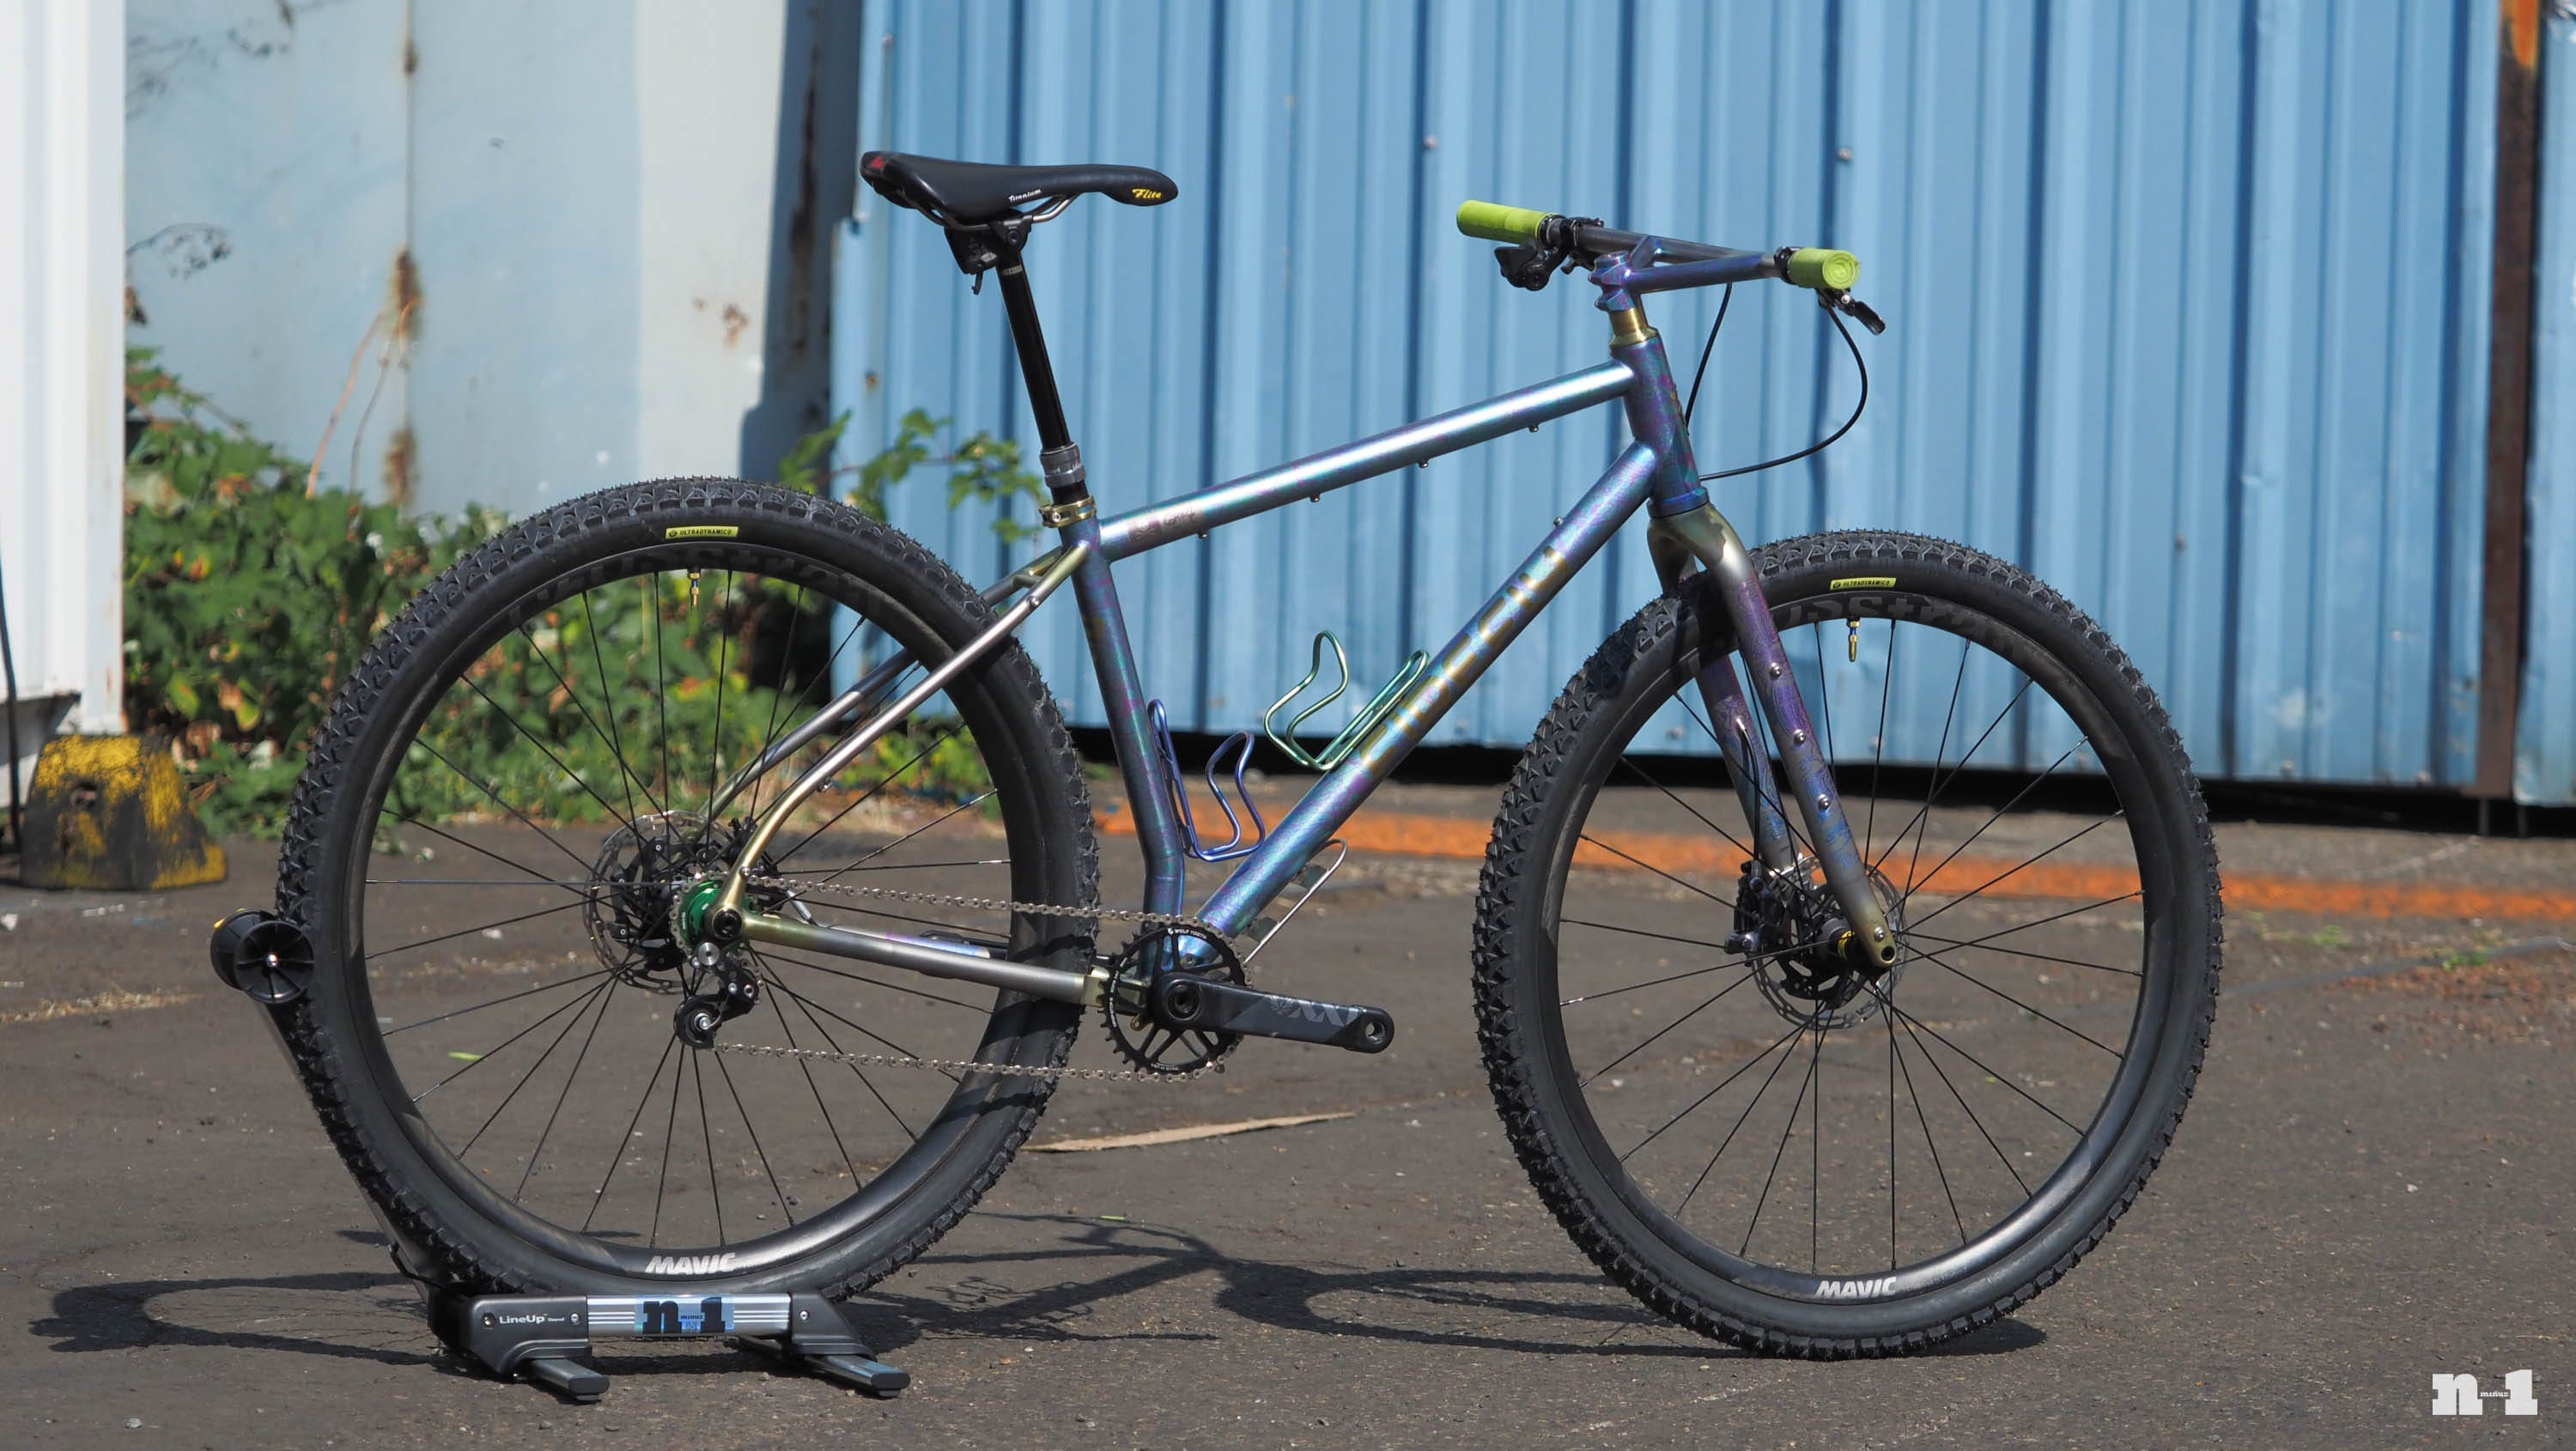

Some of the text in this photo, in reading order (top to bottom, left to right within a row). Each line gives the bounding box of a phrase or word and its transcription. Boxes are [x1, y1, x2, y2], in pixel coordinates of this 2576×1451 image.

[1132, 188, 1162, 198] Flite
[645, 1252, 736, 1275] MAVIC
[1814, 1276, 1897, 1299] MAVIC
